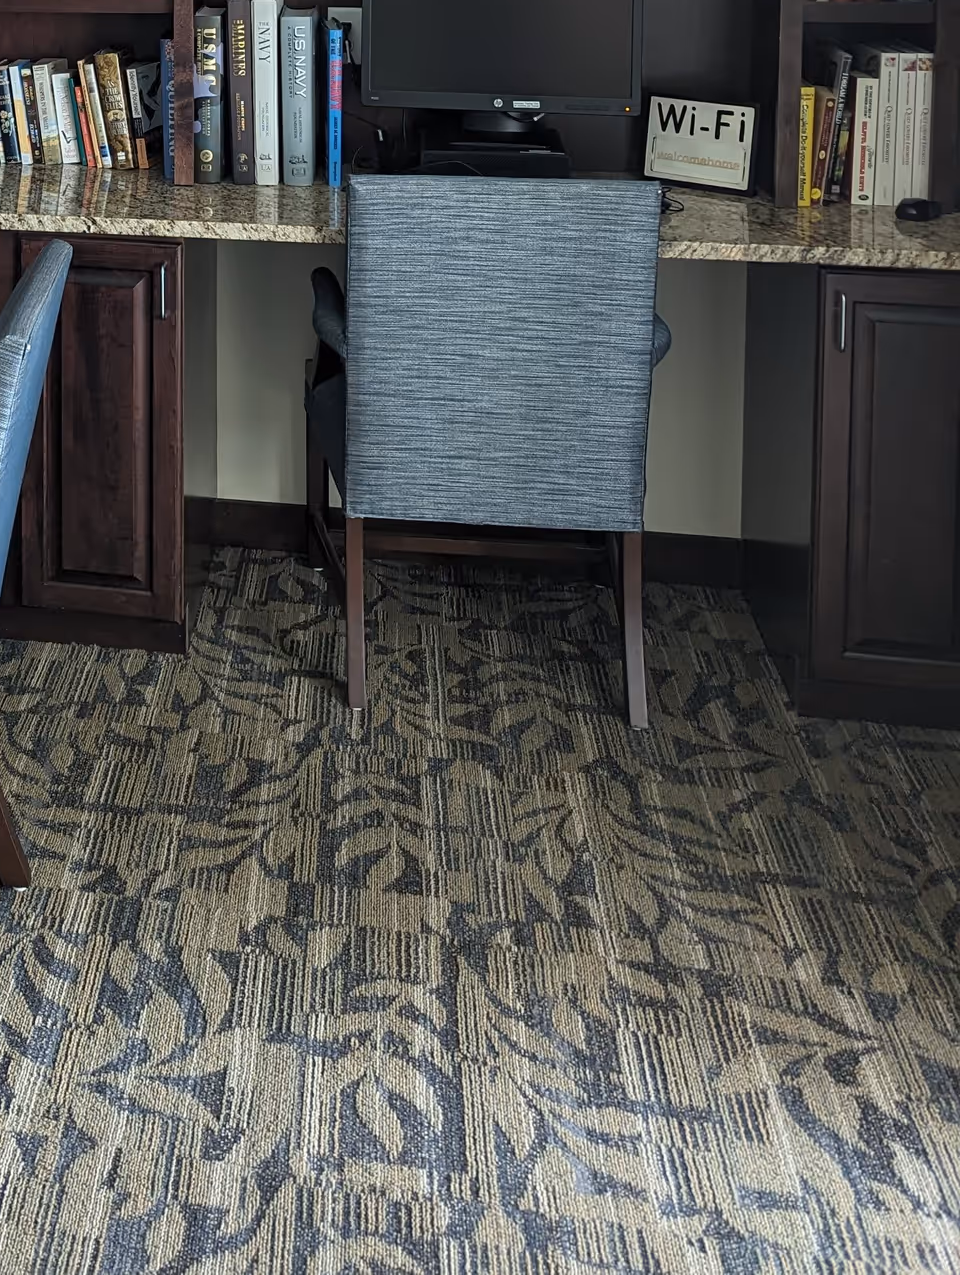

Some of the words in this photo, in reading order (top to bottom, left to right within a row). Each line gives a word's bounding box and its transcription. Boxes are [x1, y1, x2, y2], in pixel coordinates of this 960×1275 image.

[233, 24, 246, 77] MARINES
[258, 27, 271, 63] NAVY
[293, 26, 306, 53] U.S.
[129, 71, 139, 93] Identify
[294, 56, 307, 98] NAVY
[839, 76, 849, 97] DREAM
[657, 102, 746, 143] Wi-Fi
[800, 104, 809, 134] Complete
[835, 103, 844, 124] WORLD
[656, 151, 740, 169] welcomehome
[799, 135, 808, 177] Do-it-yourself
[799, 178, 808, 201] Manual
